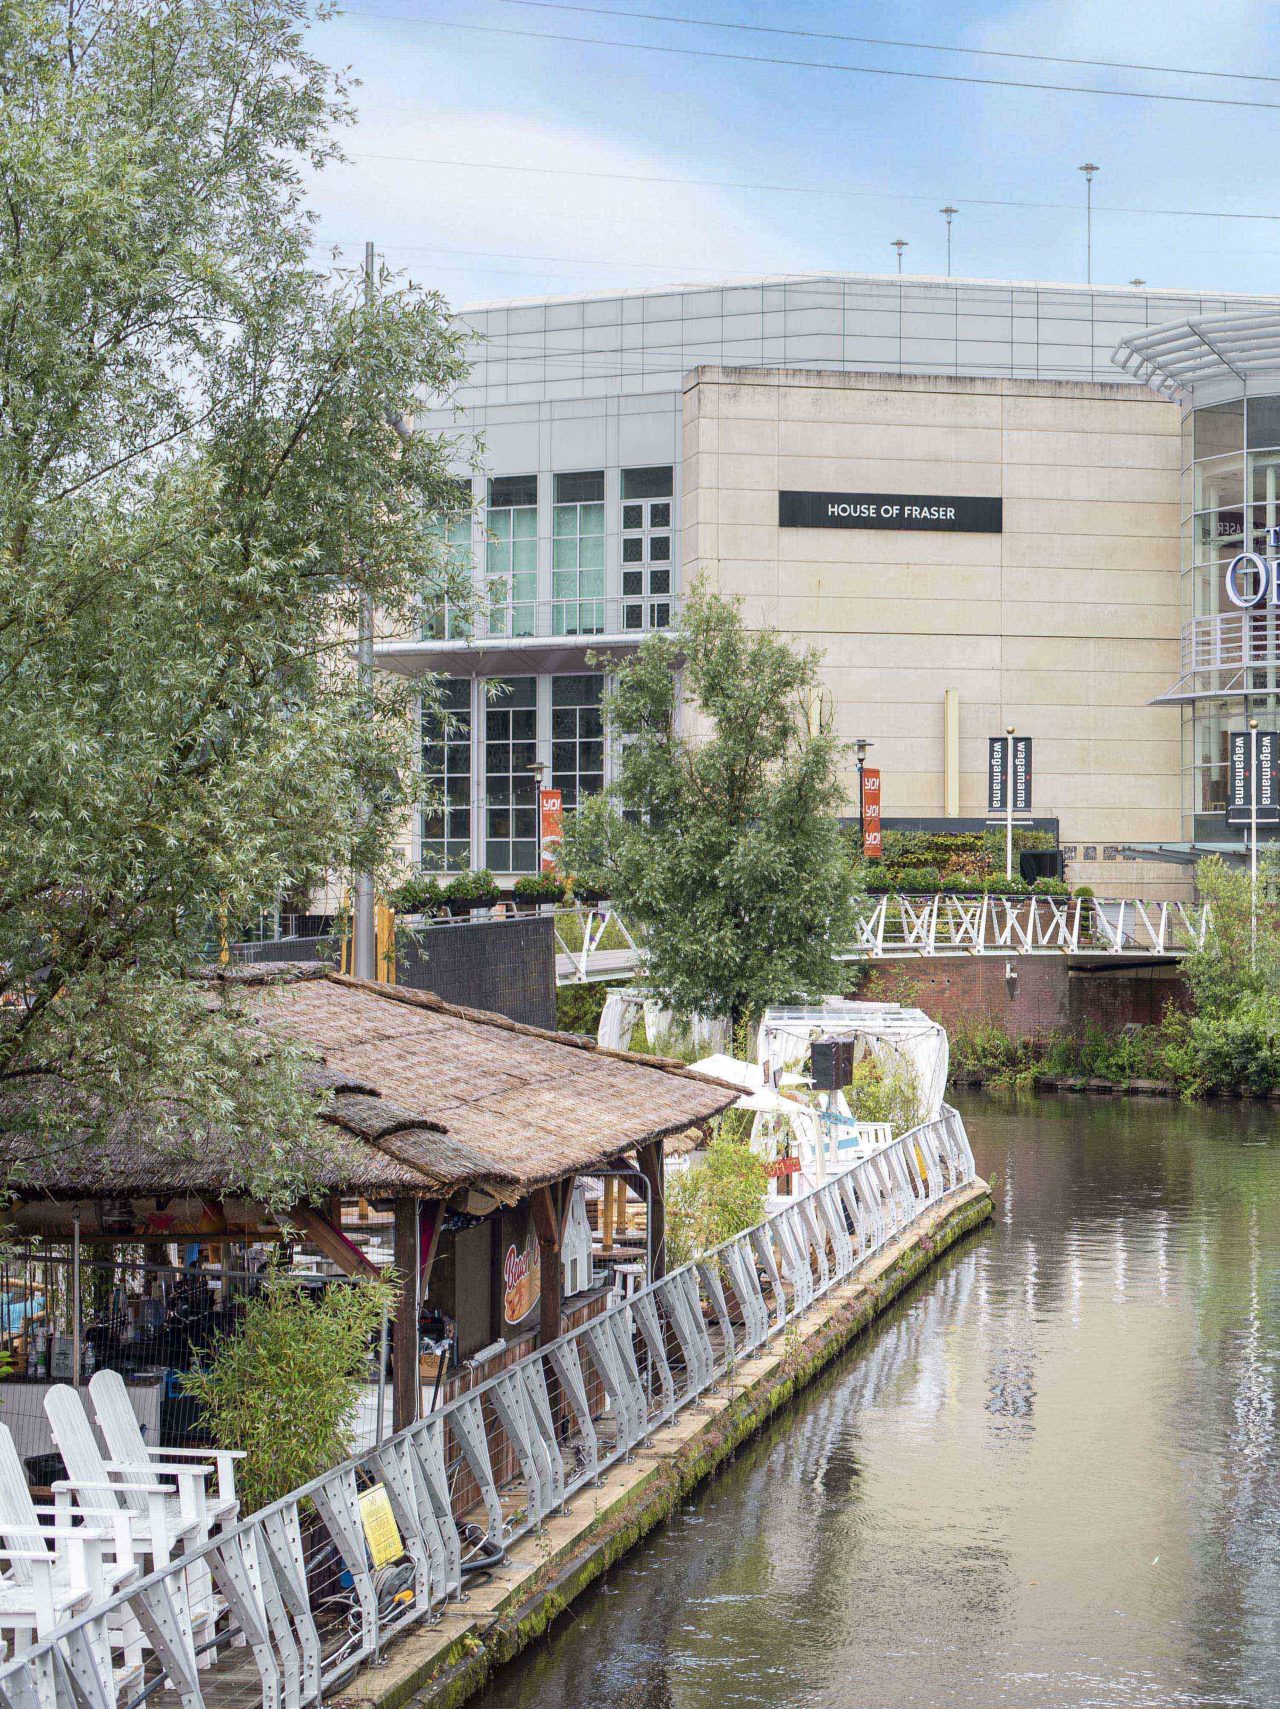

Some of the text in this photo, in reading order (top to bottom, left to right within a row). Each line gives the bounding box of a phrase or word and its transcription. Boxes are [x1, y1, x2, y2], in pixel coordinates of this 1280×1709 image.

[828, 503, 956, 520] HOUSE OF FRASER
[991, 741, 1002, 808] wagamama
[1015, 741, 1026, 808] wagamama
[1233, 736, 1245, 805] wagamama
[1259, 735, 1271, 805] wagamama
[864, 777, 879, 790] YO!
[542, 798, 561, 811] YO!
[865, 805, 879, 817] YO!
[865, 832, 880, 845] YO!
